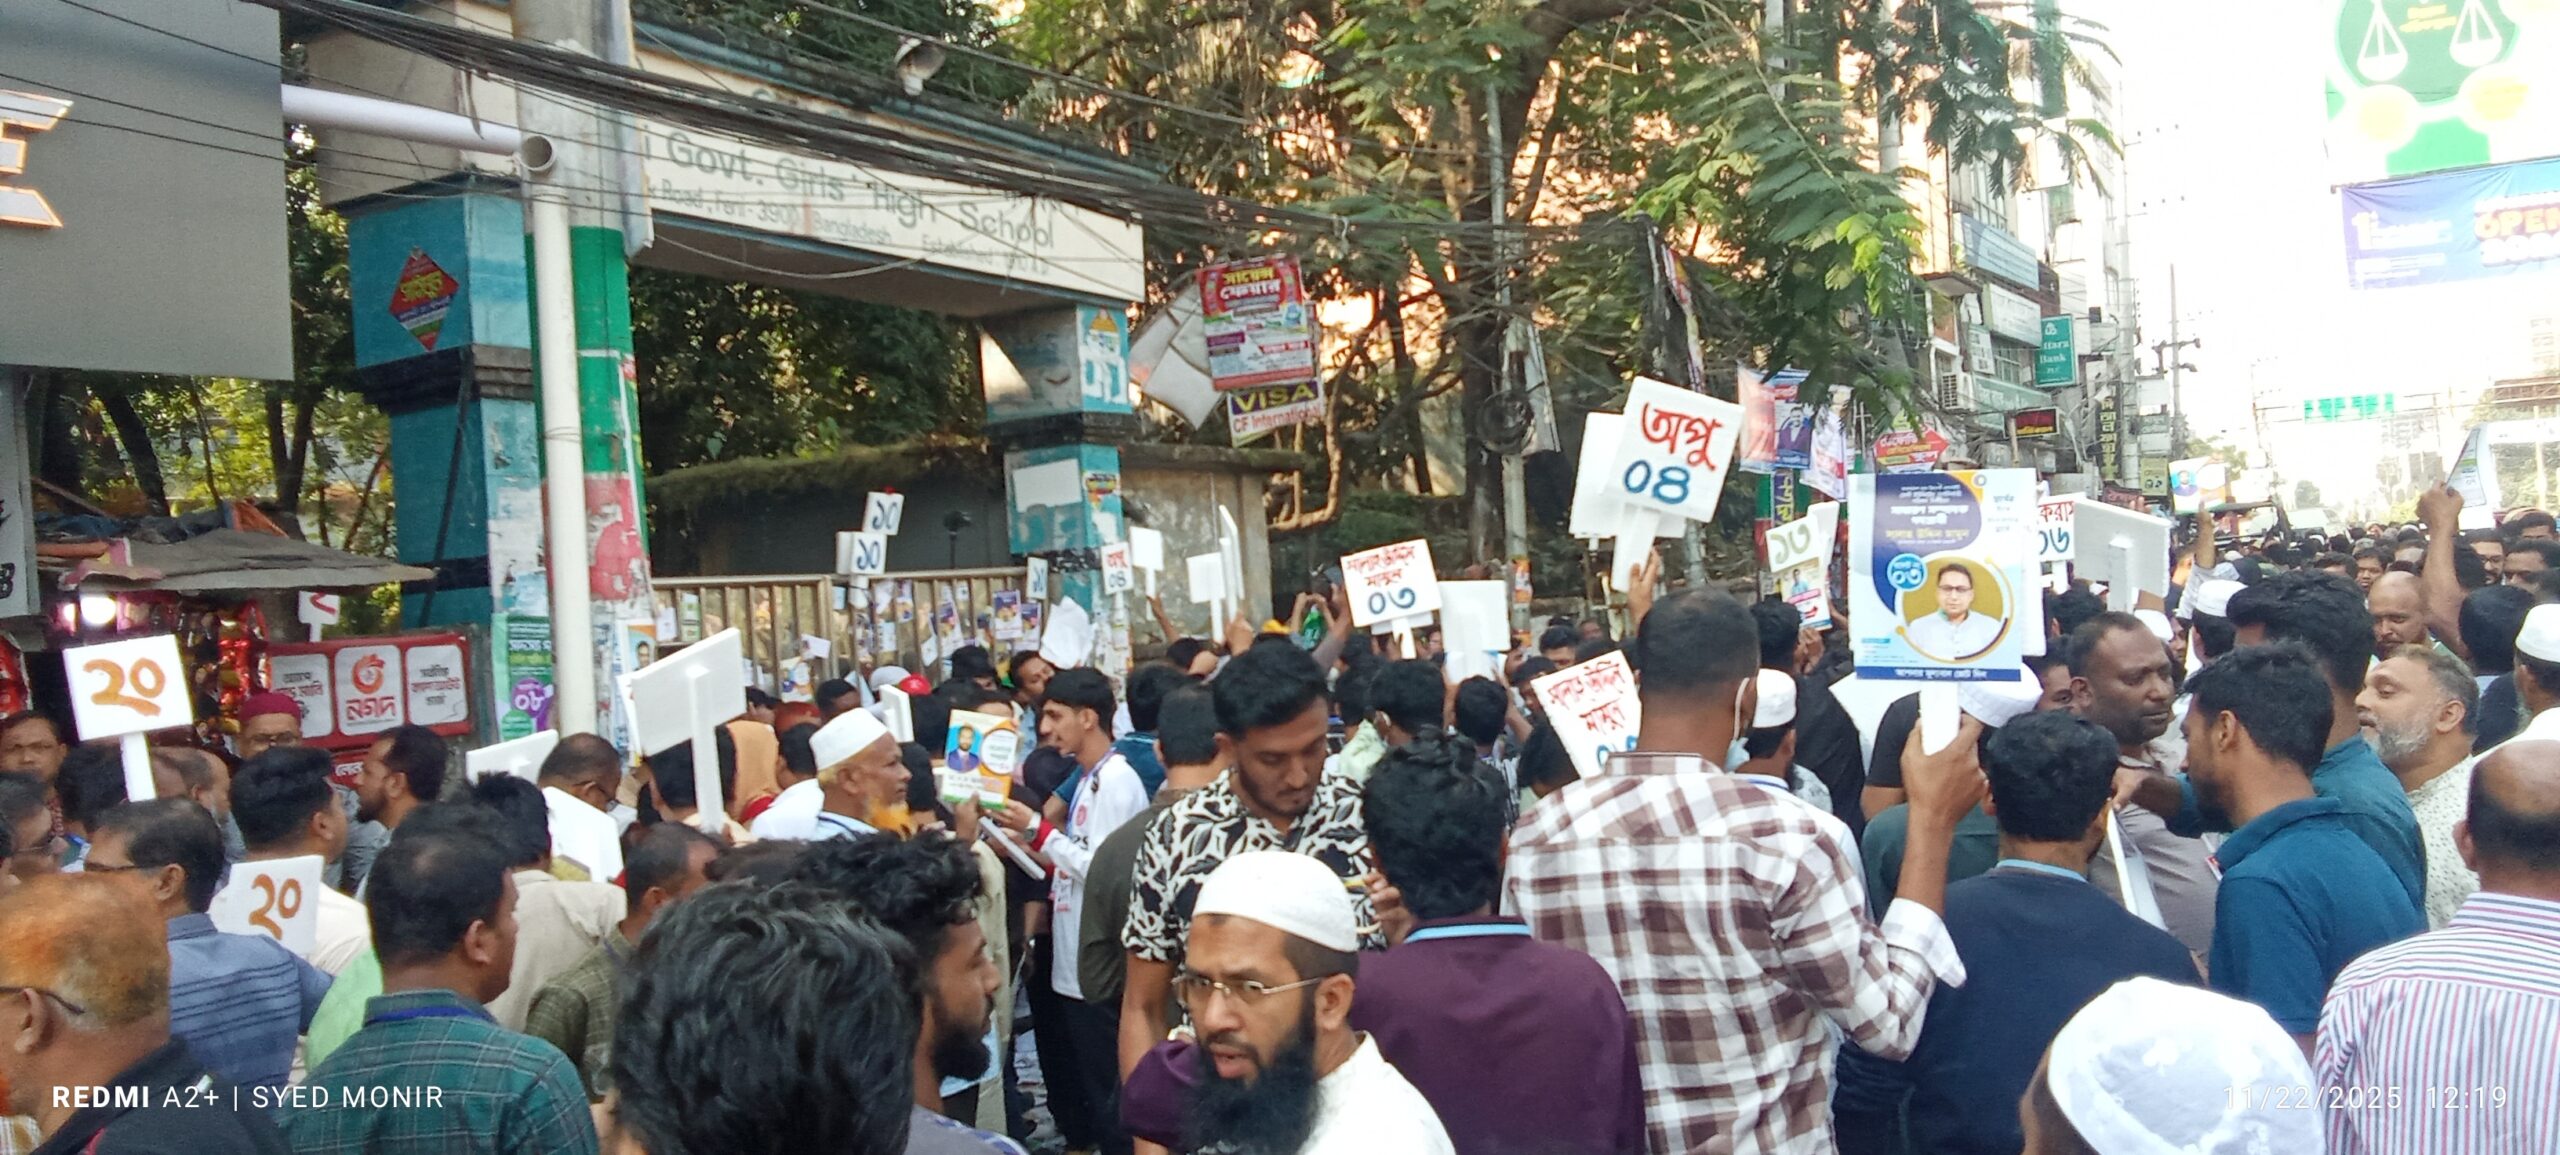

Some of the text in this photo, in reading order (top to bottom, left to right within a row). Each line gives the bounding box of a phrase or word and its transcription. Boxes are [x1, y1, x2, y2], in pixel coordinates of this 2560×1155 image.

[667, 131, 764, 186] Govt.
[873, 184, 937, 228] High
[959, 201, 1054, 248] School
[2043, 340, 2070, 350] ttara
[1235, 384, 1316, 411] VISA
[1233, 414, 1249, 433] CF
[1642, 402, 1723, 471] অপু
[1368, 586, 1416, 615] ০৩
[83, 656, 166, 717] ২০
[346, 695, 396, 721] নগদ
[514, 690, 546, 712] ০৮
[248, 873, 302, 941] ২০
